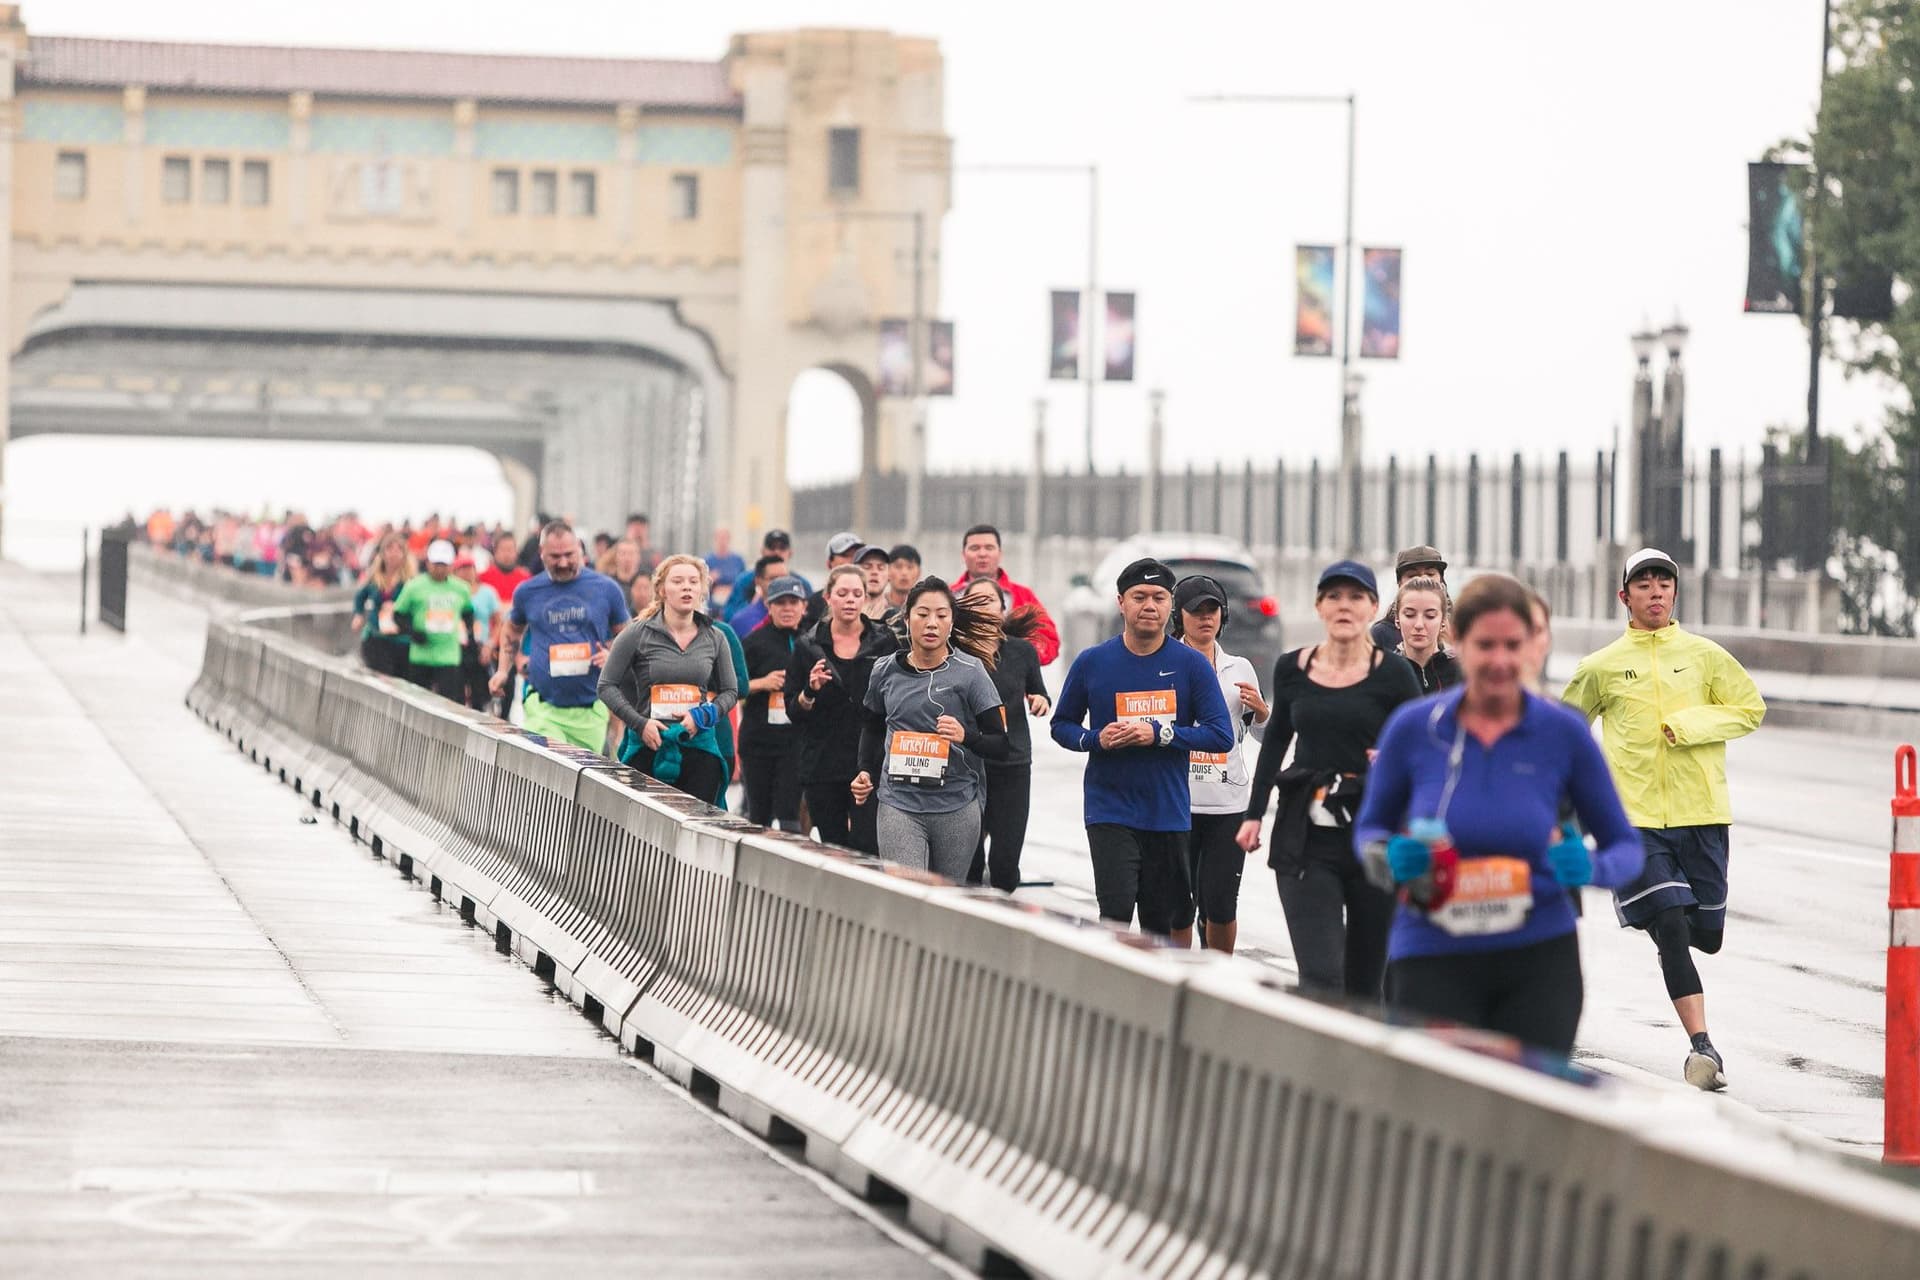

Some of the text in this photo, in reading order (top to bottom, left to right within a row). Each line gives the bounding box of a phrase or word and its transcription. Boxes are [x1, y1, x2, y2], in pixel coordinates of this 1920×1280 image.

[1125, 695, 1167, 713] TurkeyTrot
[899, 735, 940, 754] TurkeyTrot
[904, 756, 930, 768] JULING
